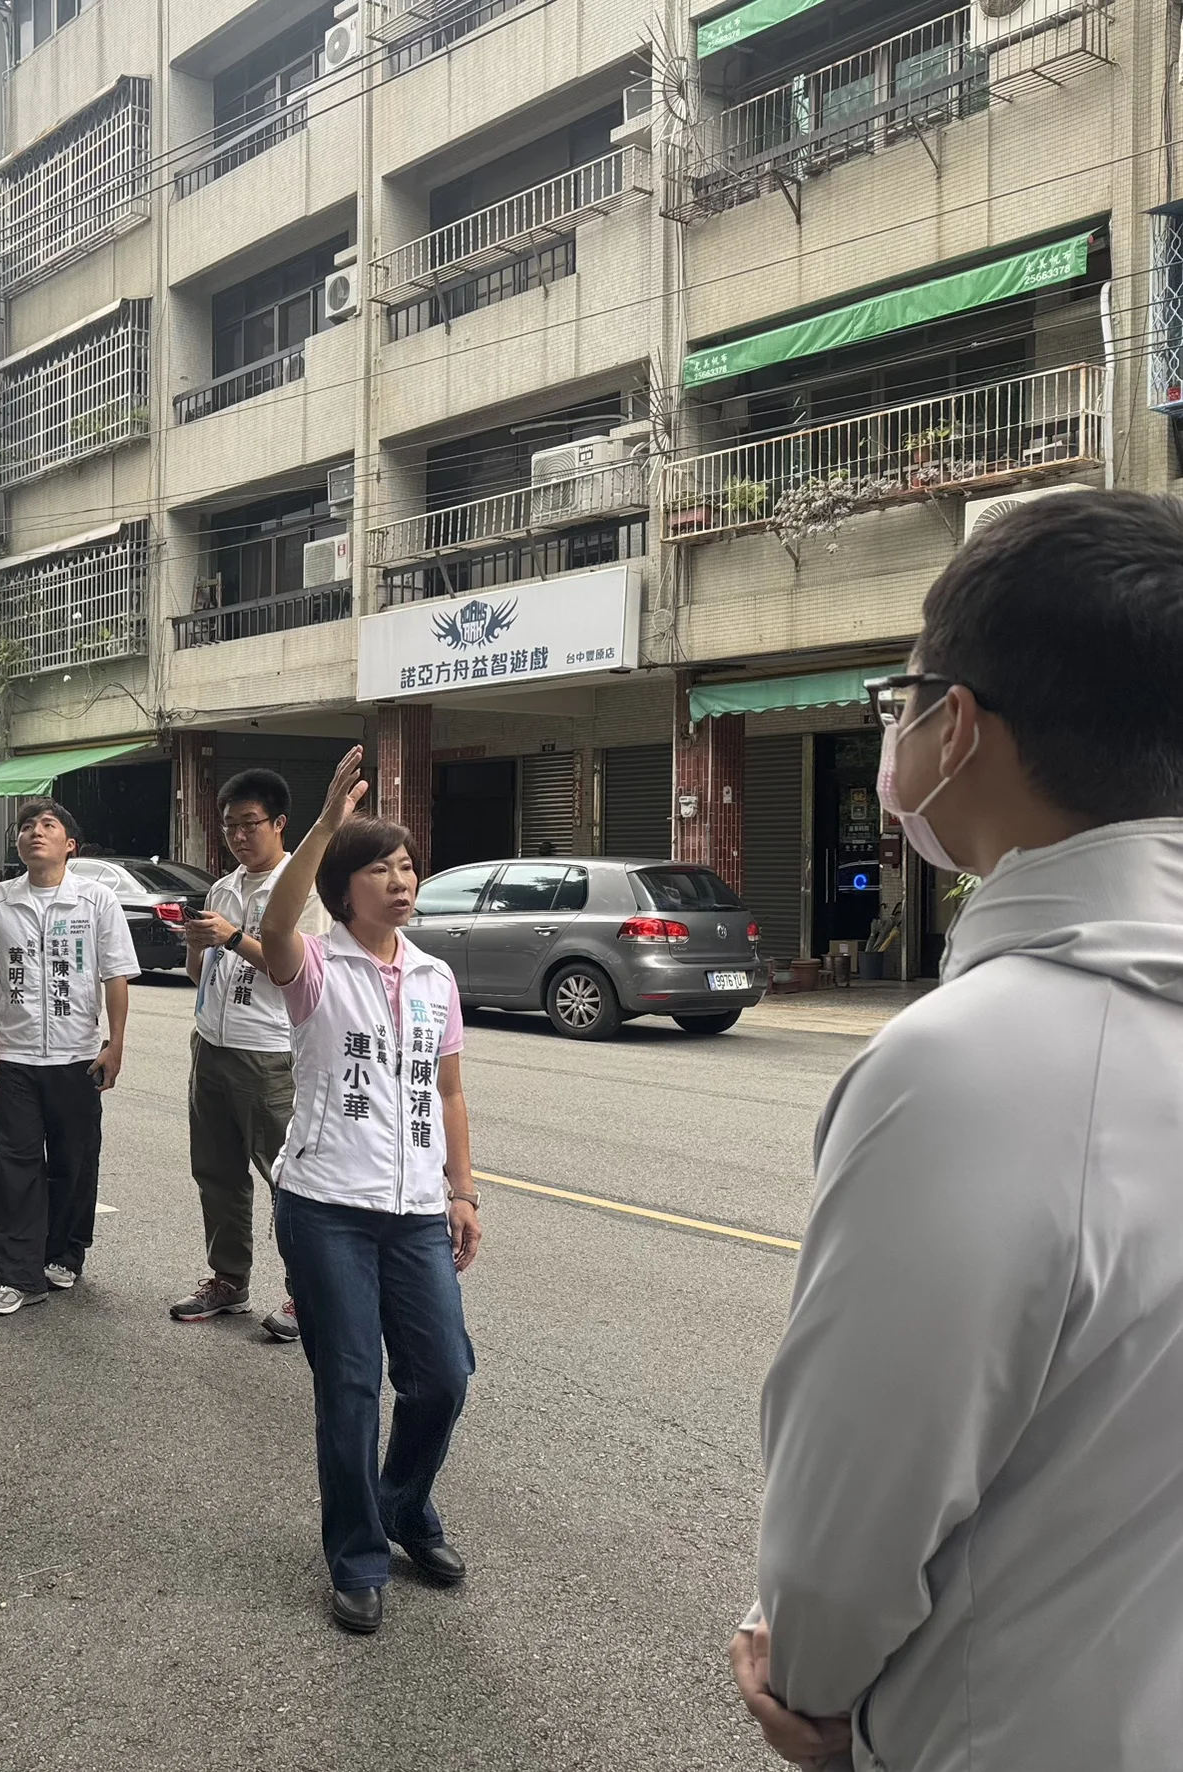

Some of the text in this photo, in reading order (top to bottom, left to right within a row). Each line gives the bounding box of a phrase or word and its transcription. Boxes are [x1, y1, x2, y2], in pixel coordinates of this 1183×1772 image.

[1023, 264, 1071, 286] 25663378
[400, 646, 549, 689] 諾亞方舟益智遊戲
[566, 647, 615, 665] 台中豐原店
[52, 960, 71, 1017] 陳清龍
[233, 957, 258, 1007] 清龍
[412, 1026, 424, 1053] 委員
[342, 1030, 372, 1122] 連小華
[410, 1059, 434, 1149] 陳清龍
